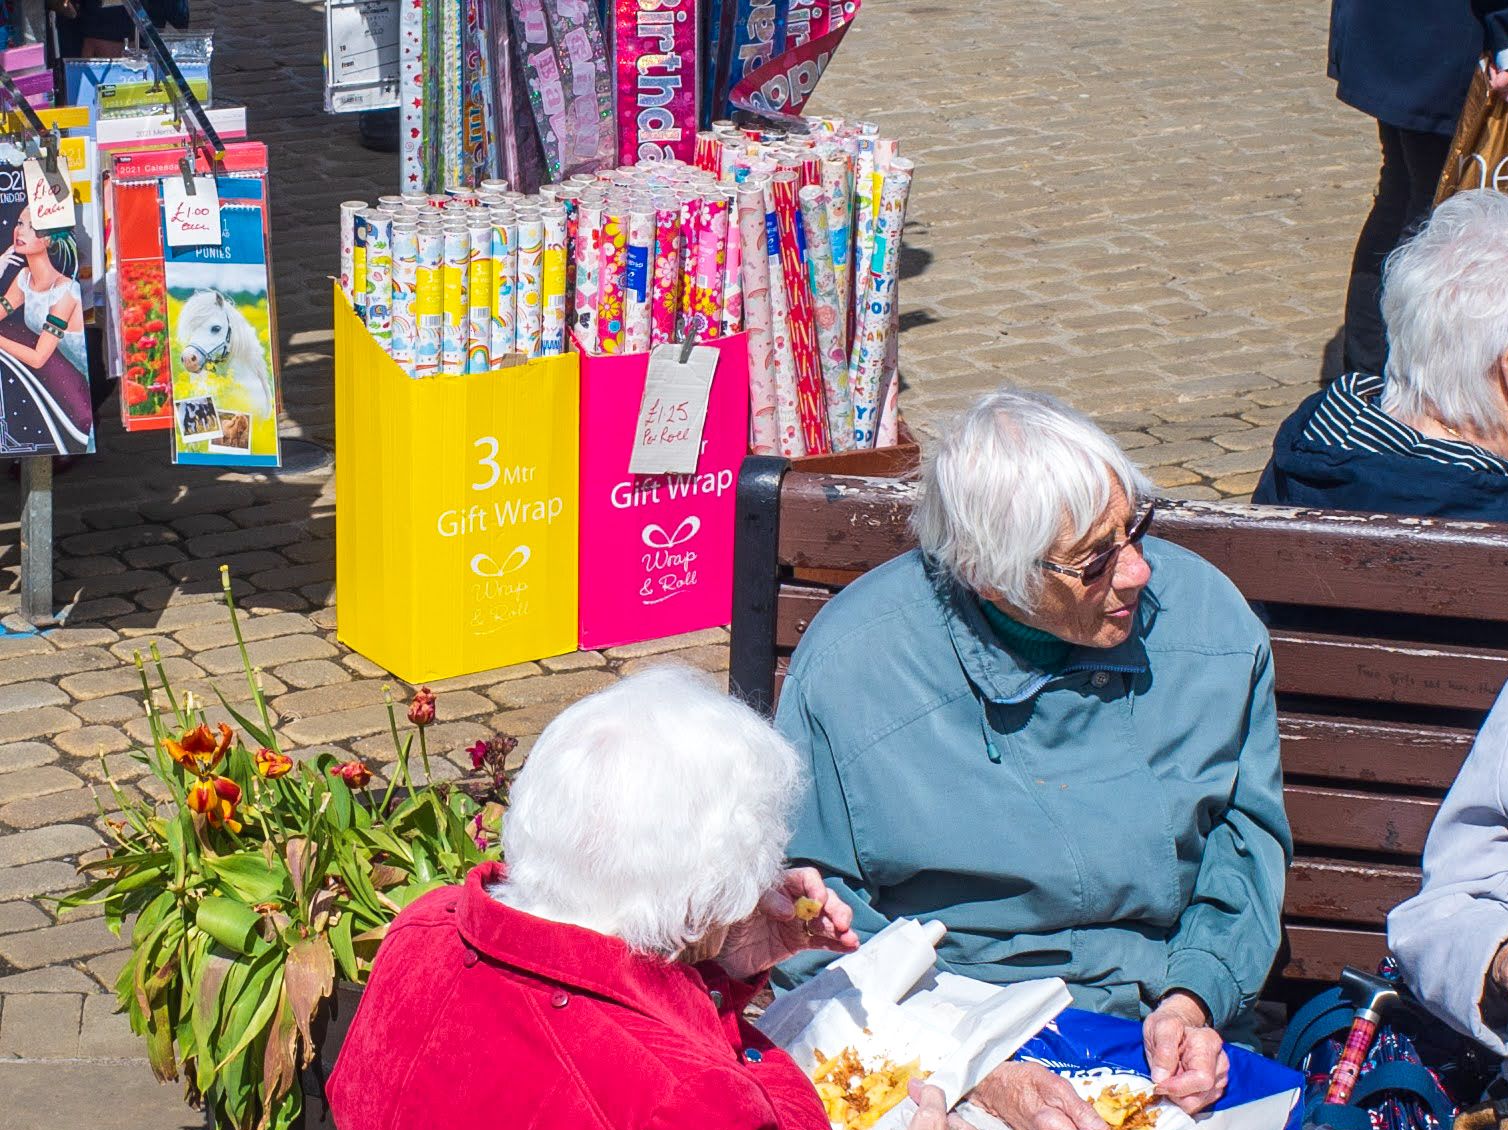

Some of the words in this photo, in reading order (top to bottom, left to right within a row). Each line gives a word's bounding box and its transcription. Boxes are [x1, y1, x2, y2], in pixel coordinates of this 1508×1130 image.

[636, 0, 682, 162] irthda
[0, 170, 25, 191] 021
[120, 165, 141, 175] 2021
[144, 163, 179, 173] Calenda
[171, 202, 210, 222] £1.00
[472, 435, 501, 491] 3
[503, 464, 537, 486] Mtr
[610, 477, 661, 509] Gift
[666, 468, 734, 501] Wrap
[437, 504, 488, 537] Gift
[494, 495, 563, 527] Wrap
[642, 550, 698, 572] Wrap
[639, 579, 654, 597] &
[658, 570, 698, 592] Roll
